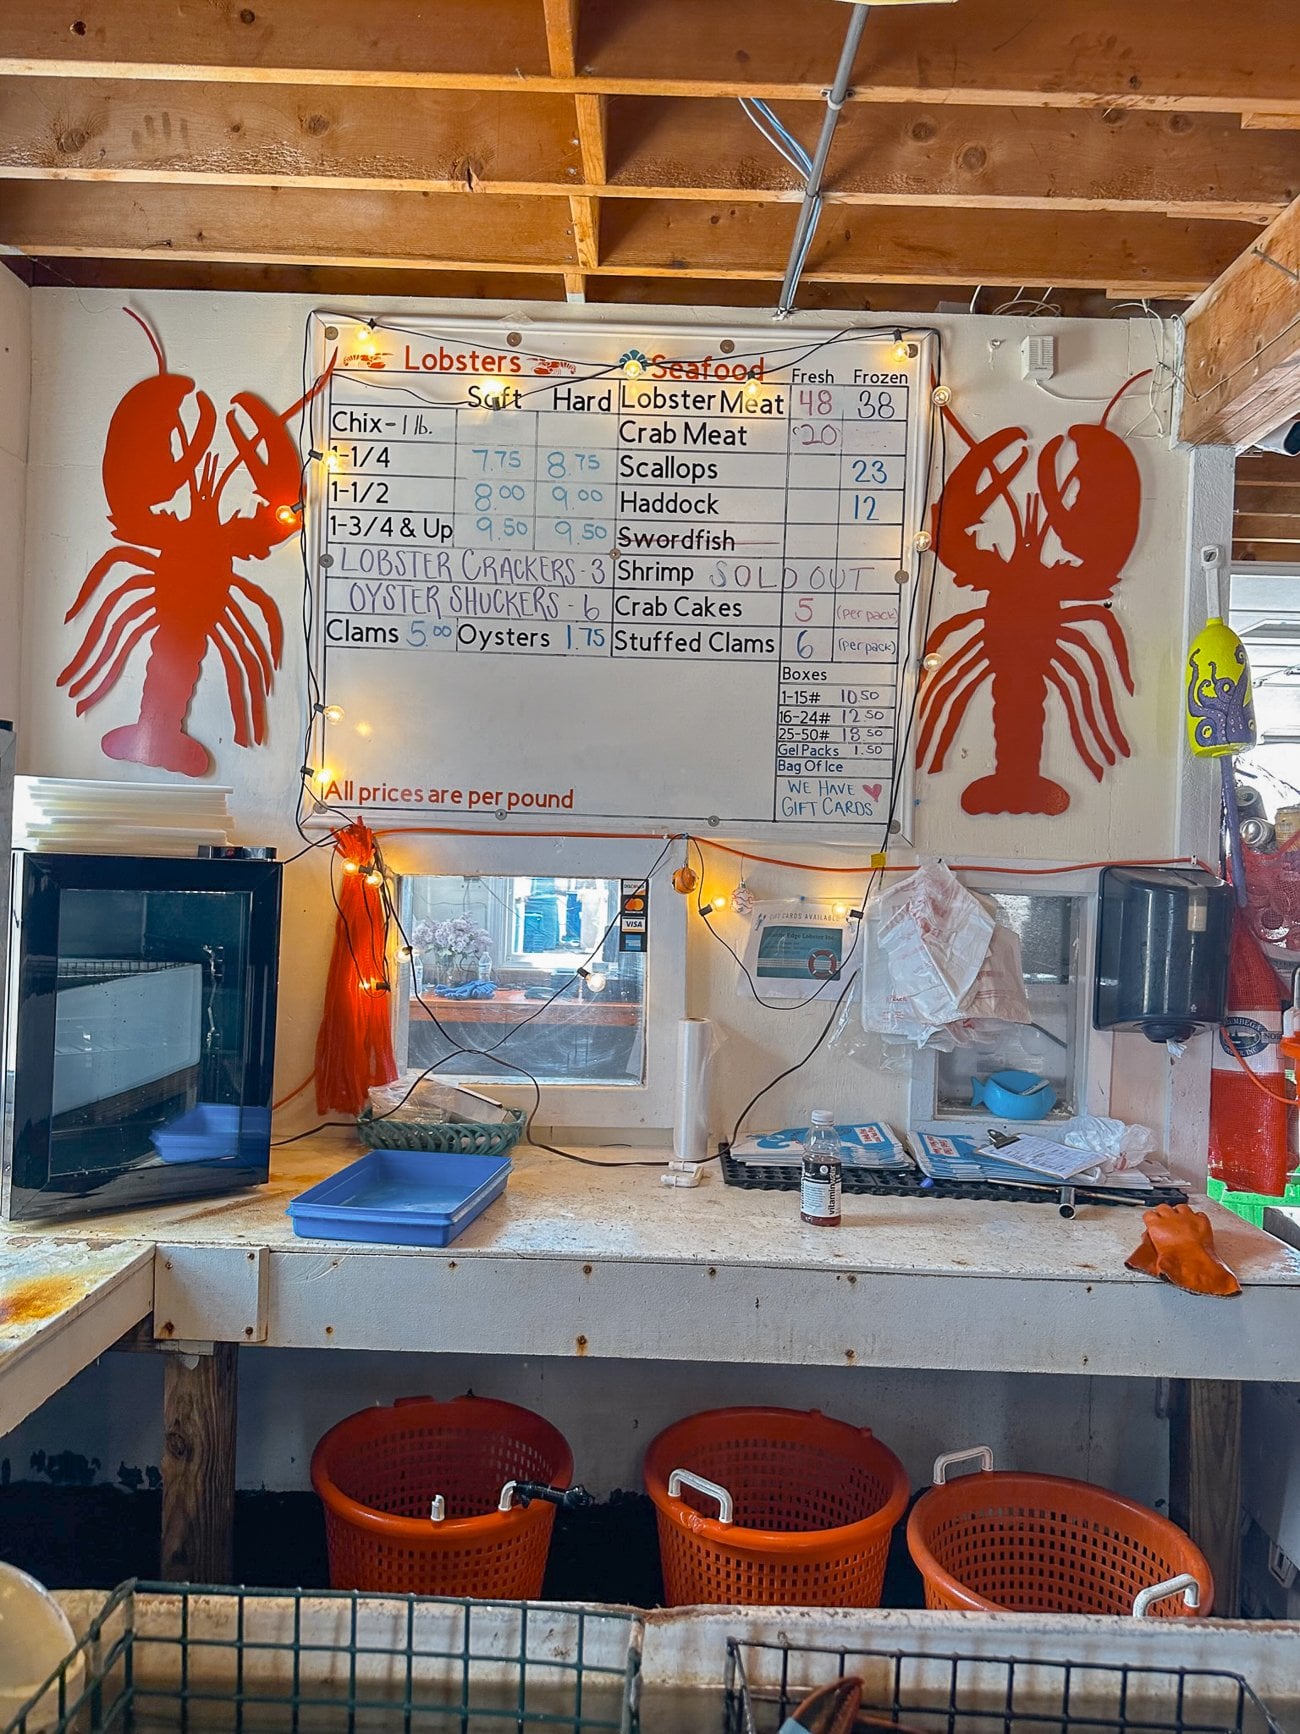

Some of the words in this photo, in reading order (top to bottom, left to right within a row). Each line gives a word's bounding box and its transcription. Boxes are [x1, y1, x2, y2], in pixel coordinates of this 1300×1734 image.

[405, 345, 522, 373] Lobsters
[651, 354, 765, 381] Seafood
[792, 369, 834, 384] Fresh
[854, 369, 909, 385] Frozen
[467, 385, 522, 409] Soft
[553, 388, 611, 412] Hard
[621, 385, 717, 411] Lobster
[720, 390, 785, 415] Meat
[799, 390, 833, 416] 48
[857, 390, 896, 419] 38
[619, 420, 677, 444] Crab
[684, 422, 748, 446] Meat
[800, 423, 838, 446] 20
[472, 450, 521, 472] 7.75
[547, 452, 600, 478] 8.75
[620, 454, 718, 483] Scallops
[852, 459, 888, 484] 23
[331, 482, 389, 504] 1-1/2
[475, 483, 525, 512] 8.00
[552, 486, 603, 511] 9.00
[620, 491, 719, 515] Haddock
[853, 494, 880, 520] 12
[330, 516, 394, 538] 1-3/4
[400, 517, 417, 538] &
[423, 518, 453, 543] Up
[476, 516, 528, 541] 9.50
[554, 520, 608, 545] 9.50
[617, 526, 736, 551] Swordfish
[341, 547, 453, 583] LOBSTER
[461, 548, 576, 588] CRACKERS
[591, 558, 606, 584] 3
[617, 559, 694, 586] Shrimp
[709, 560, 799, 590] SOLD
[809, 565, 876, 592] OUT
[350, 582, 442, 619] OYSTER
[450, 585, 559, 621] SHUCKERS
[584, 593, 601, 621] 6
[615, 595, 668, 618] Crab
[674, 596, 743, 619] Cakes
[794, 598, 815, 622] 5
[326, 618, 400, 643] Clams
[457, 623, 551, 651] Oysters
[567, 624, 606, 650] 1.75
[614, 630, 702, 653] Stuffed
[709, 631, 775, 654] Clams
[796, 629, 815, 659] 6
[782, 666, 828, 681] Boxes
[782, 690, 821, 705] 1-15#
[780, 710, 831, 725] 16-24#
[779, 727, 831, 741] 25-50#
[778, 743, 799, 757] Gel
[801, 743, 840, 757] Packs
[854, 745, 883, 756] 1.50
[778, 759, 801, 775] Bag
[804, 760, 822, 773] Of
[825, 760, 844, 773] Ice
[325, 780, 354, 801] All
[359, 783, 424, 806] prices
[429, 788, 463, 804] are
[469, 789, 503, 810] per
[508, 788, 574, 811] pound
[625, 920, 643, 928] VISA
